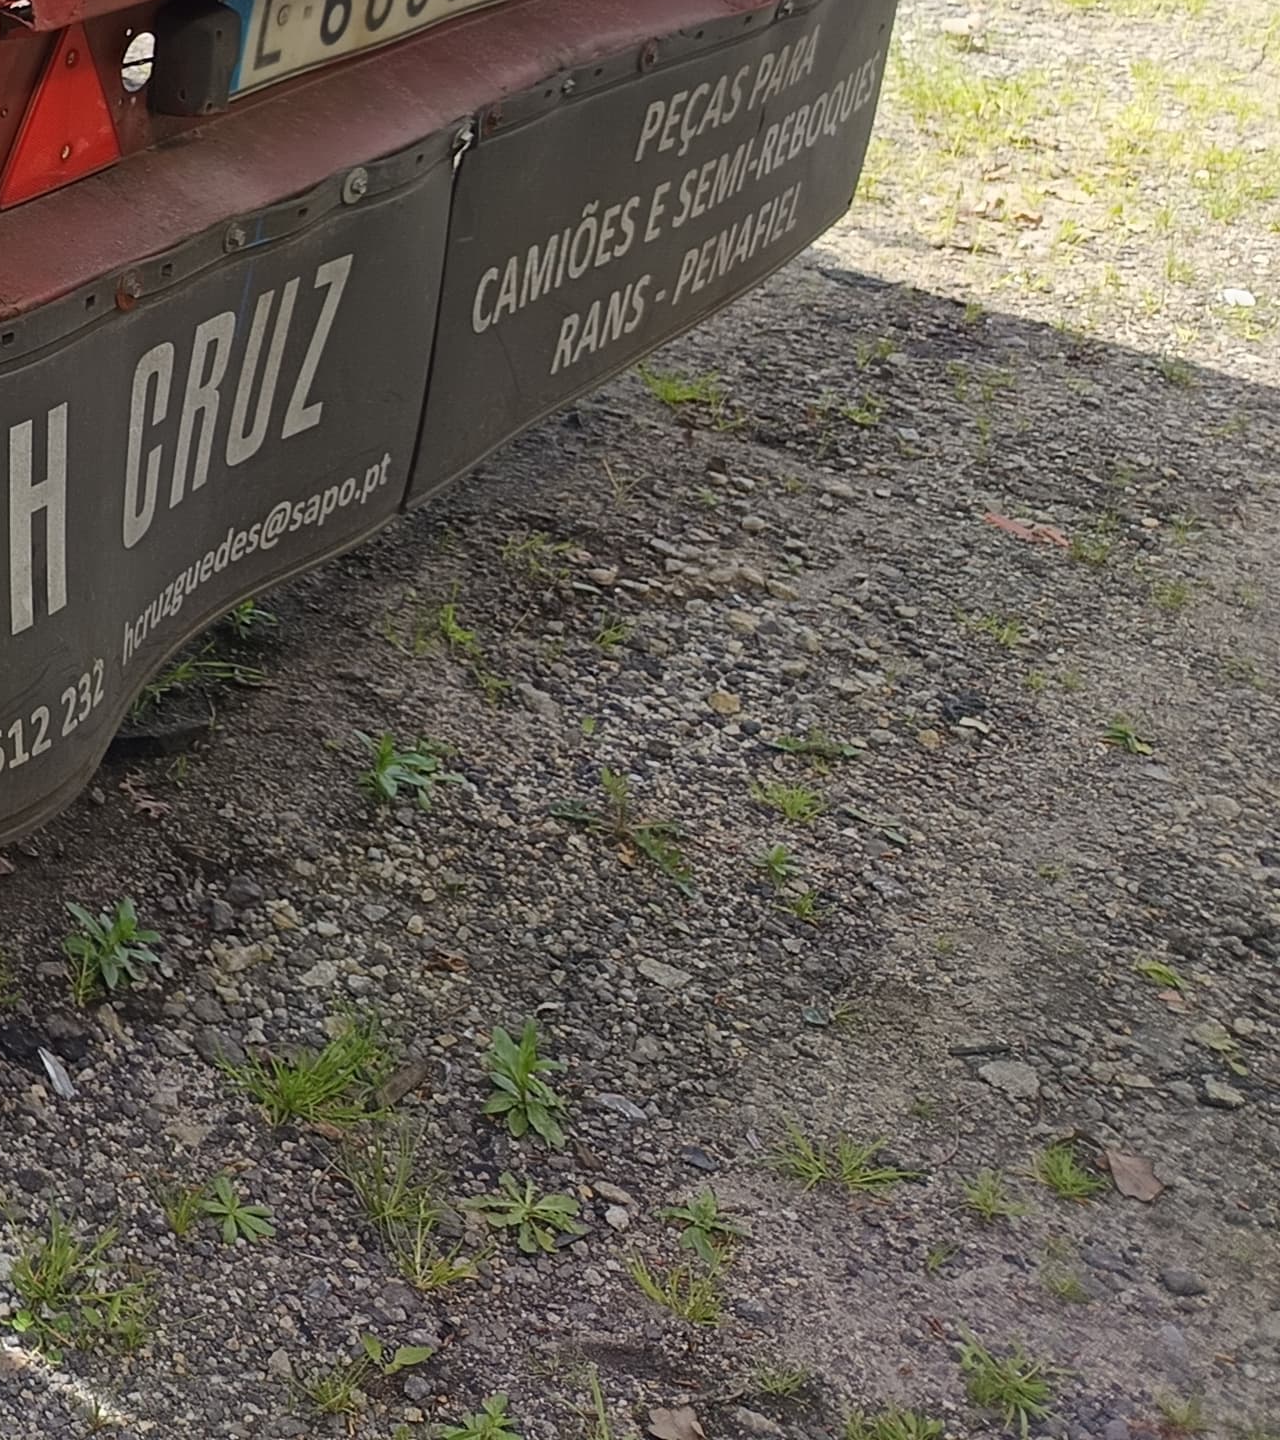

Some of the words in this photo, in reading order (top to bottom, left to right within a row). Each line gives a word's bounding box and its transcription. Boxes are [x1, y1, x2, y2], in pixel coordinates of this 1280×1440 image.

[472, 200, 640, 335] CAMIÕES
[643, 182, 672, 244] E
[672, 50, 882, 229] SEMI-REBOQUES
[636, 68, 743, 162] PEÇAS
[747, 25, 821, 111] PARA
[550, 274, 651, 376] RANS
[672, 182, 802, 305] PENAFIEL
[8, 402, 68, 636] H
[123, 253, 354, 549] CRUZ
[122, 452, 391, 666] hcruzguedes@sapo.pt
[61, 658, 105, 737] 232
